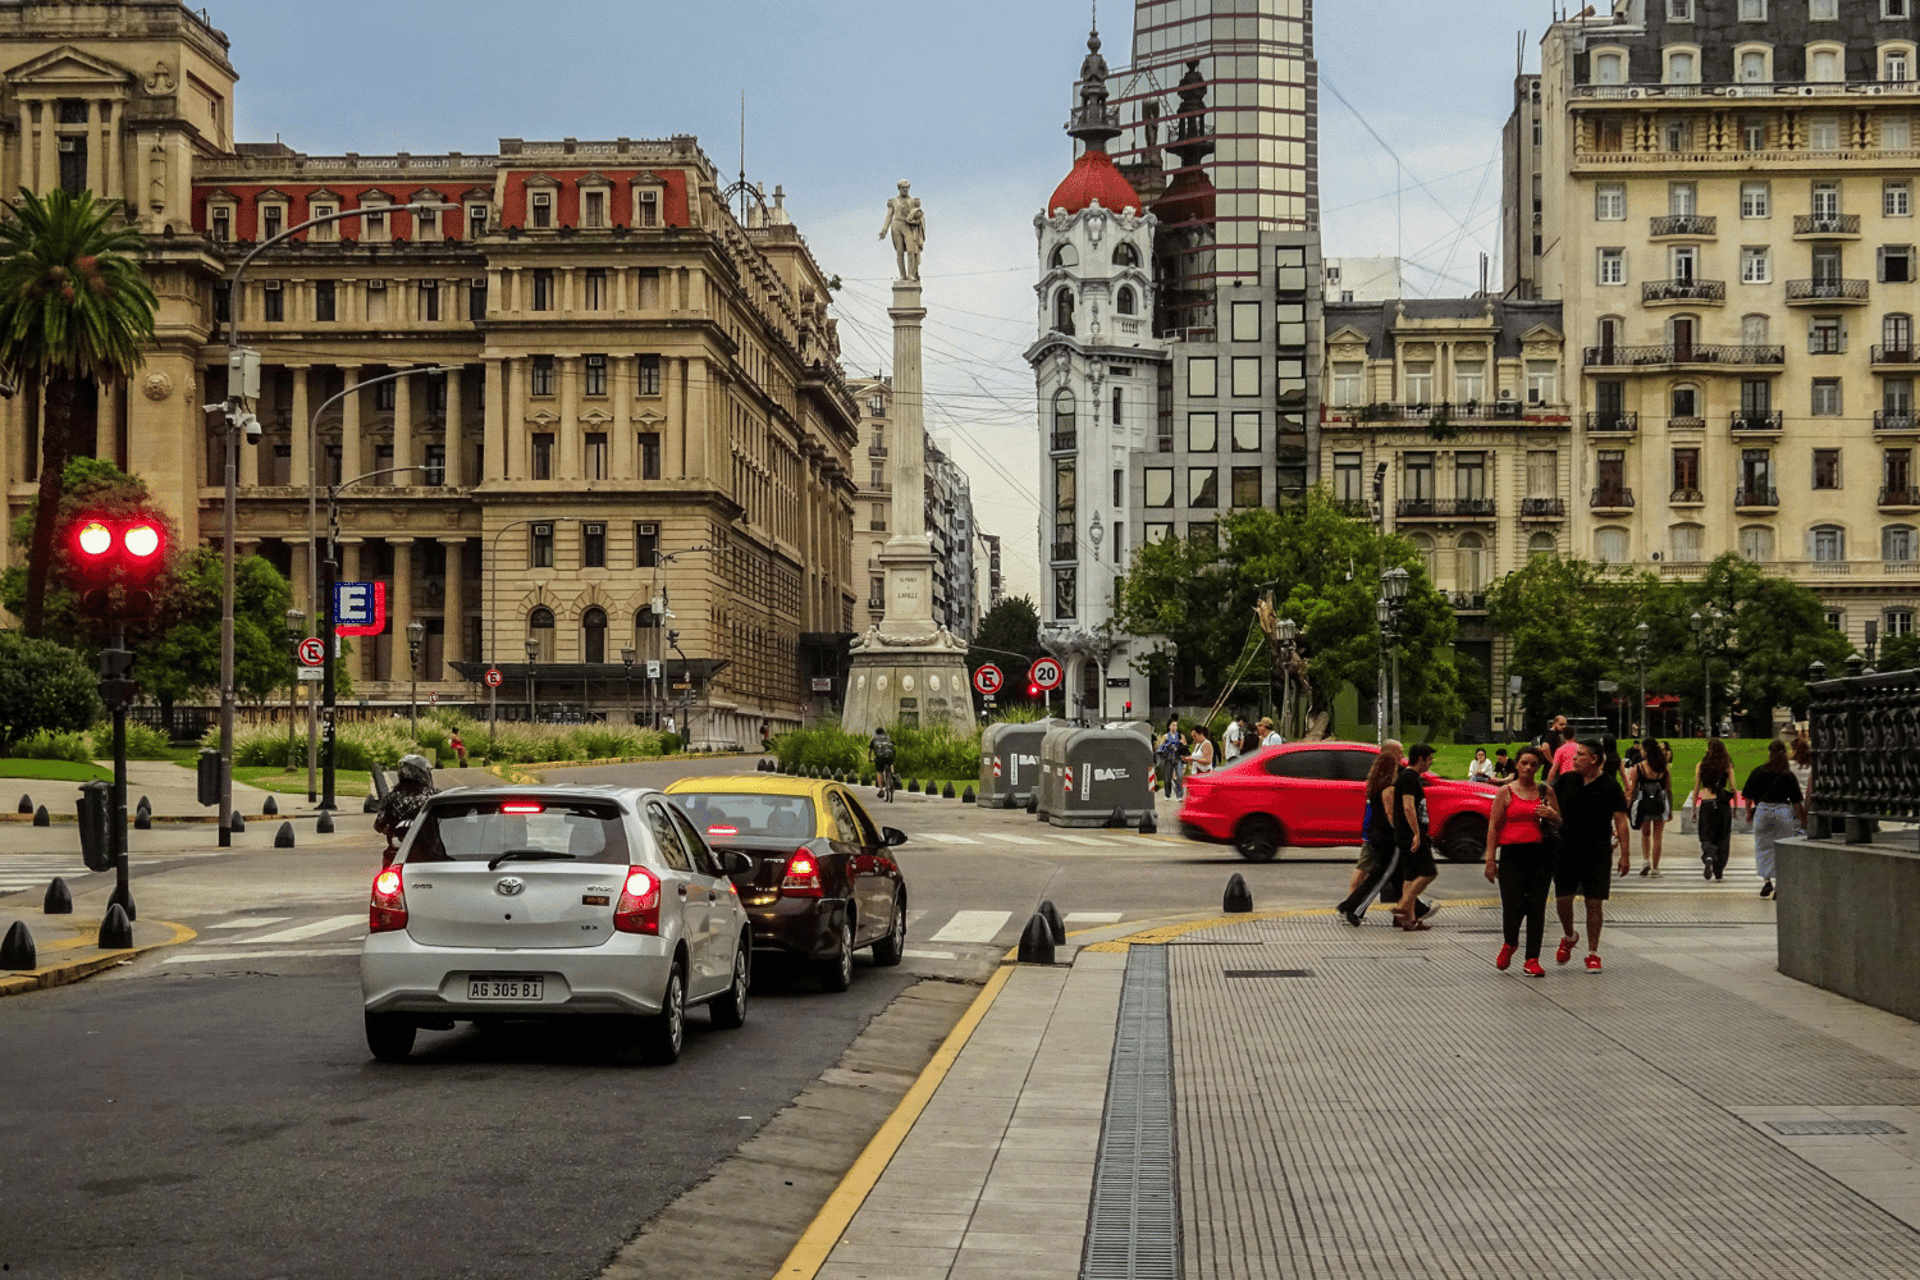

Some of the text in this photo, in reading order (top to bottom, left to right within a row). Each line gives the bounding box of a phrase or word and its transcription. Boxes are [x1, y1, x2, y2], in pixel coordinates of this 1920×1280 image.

[340, 586, 366, 619] E
[982, 671, 994, 688] E
[1038, 667, 1055, 681] 20
[1019, 754, 1036, 765] BA
[1094, 767, 1116, 781] BA
[471, 983, 538, 997] AG 305 BI
